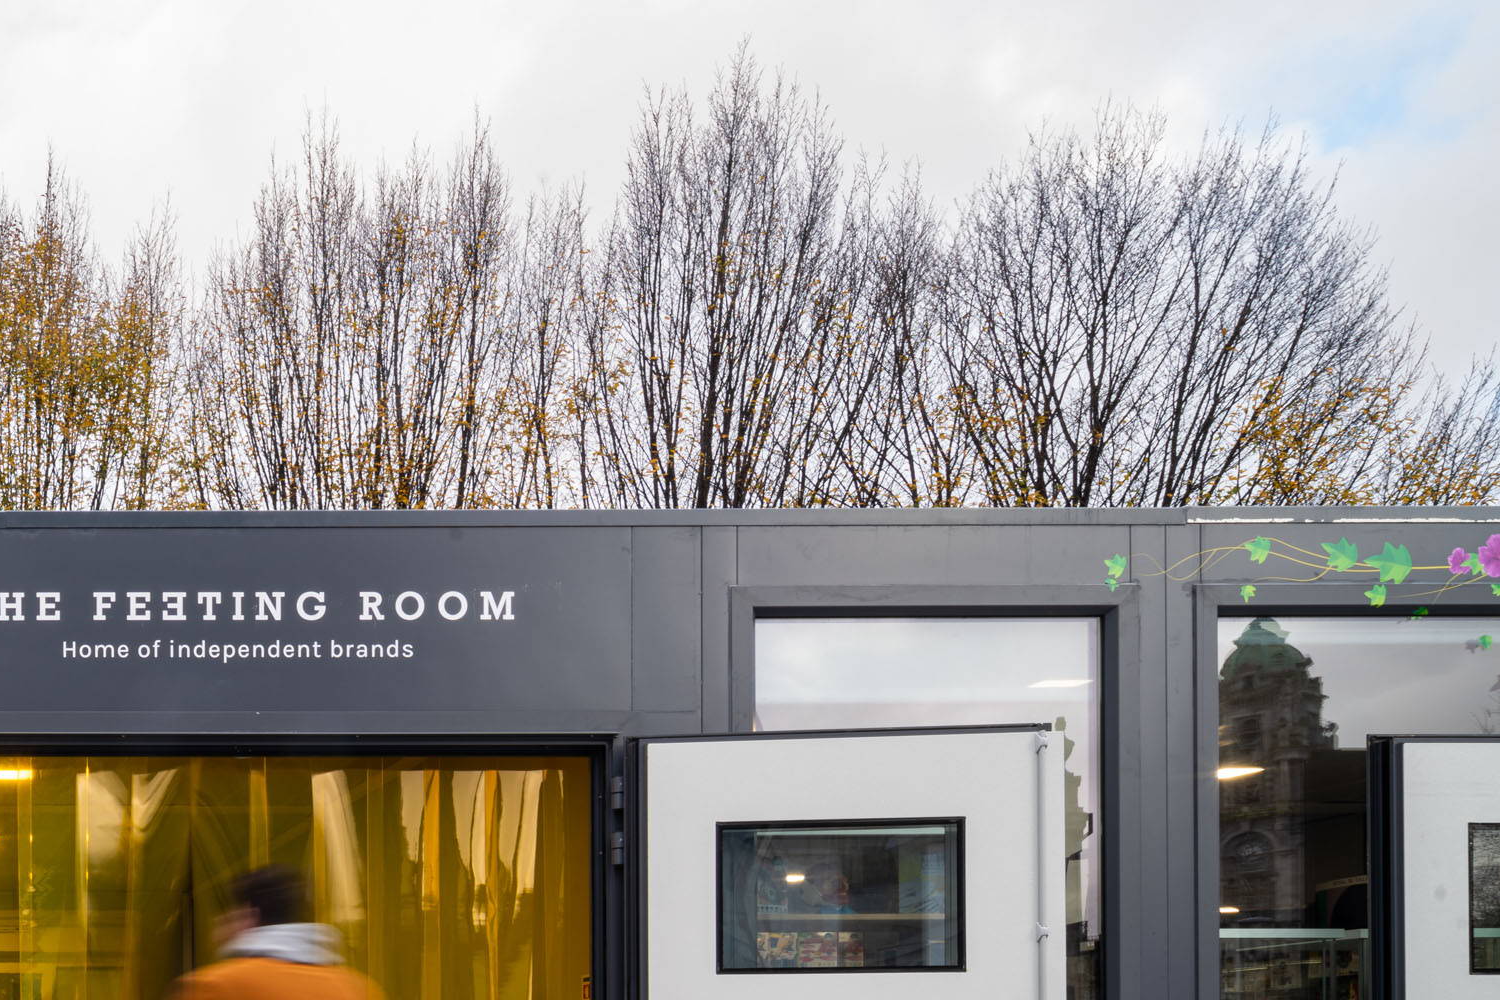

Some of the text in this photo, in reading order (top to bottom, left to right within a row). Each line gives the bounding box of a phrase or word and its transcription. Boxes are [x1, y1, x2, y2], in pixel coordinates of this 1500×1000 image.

[359, 590, 516, 622] ROOM
[62, 639, 415, 664] Home of independent brands
